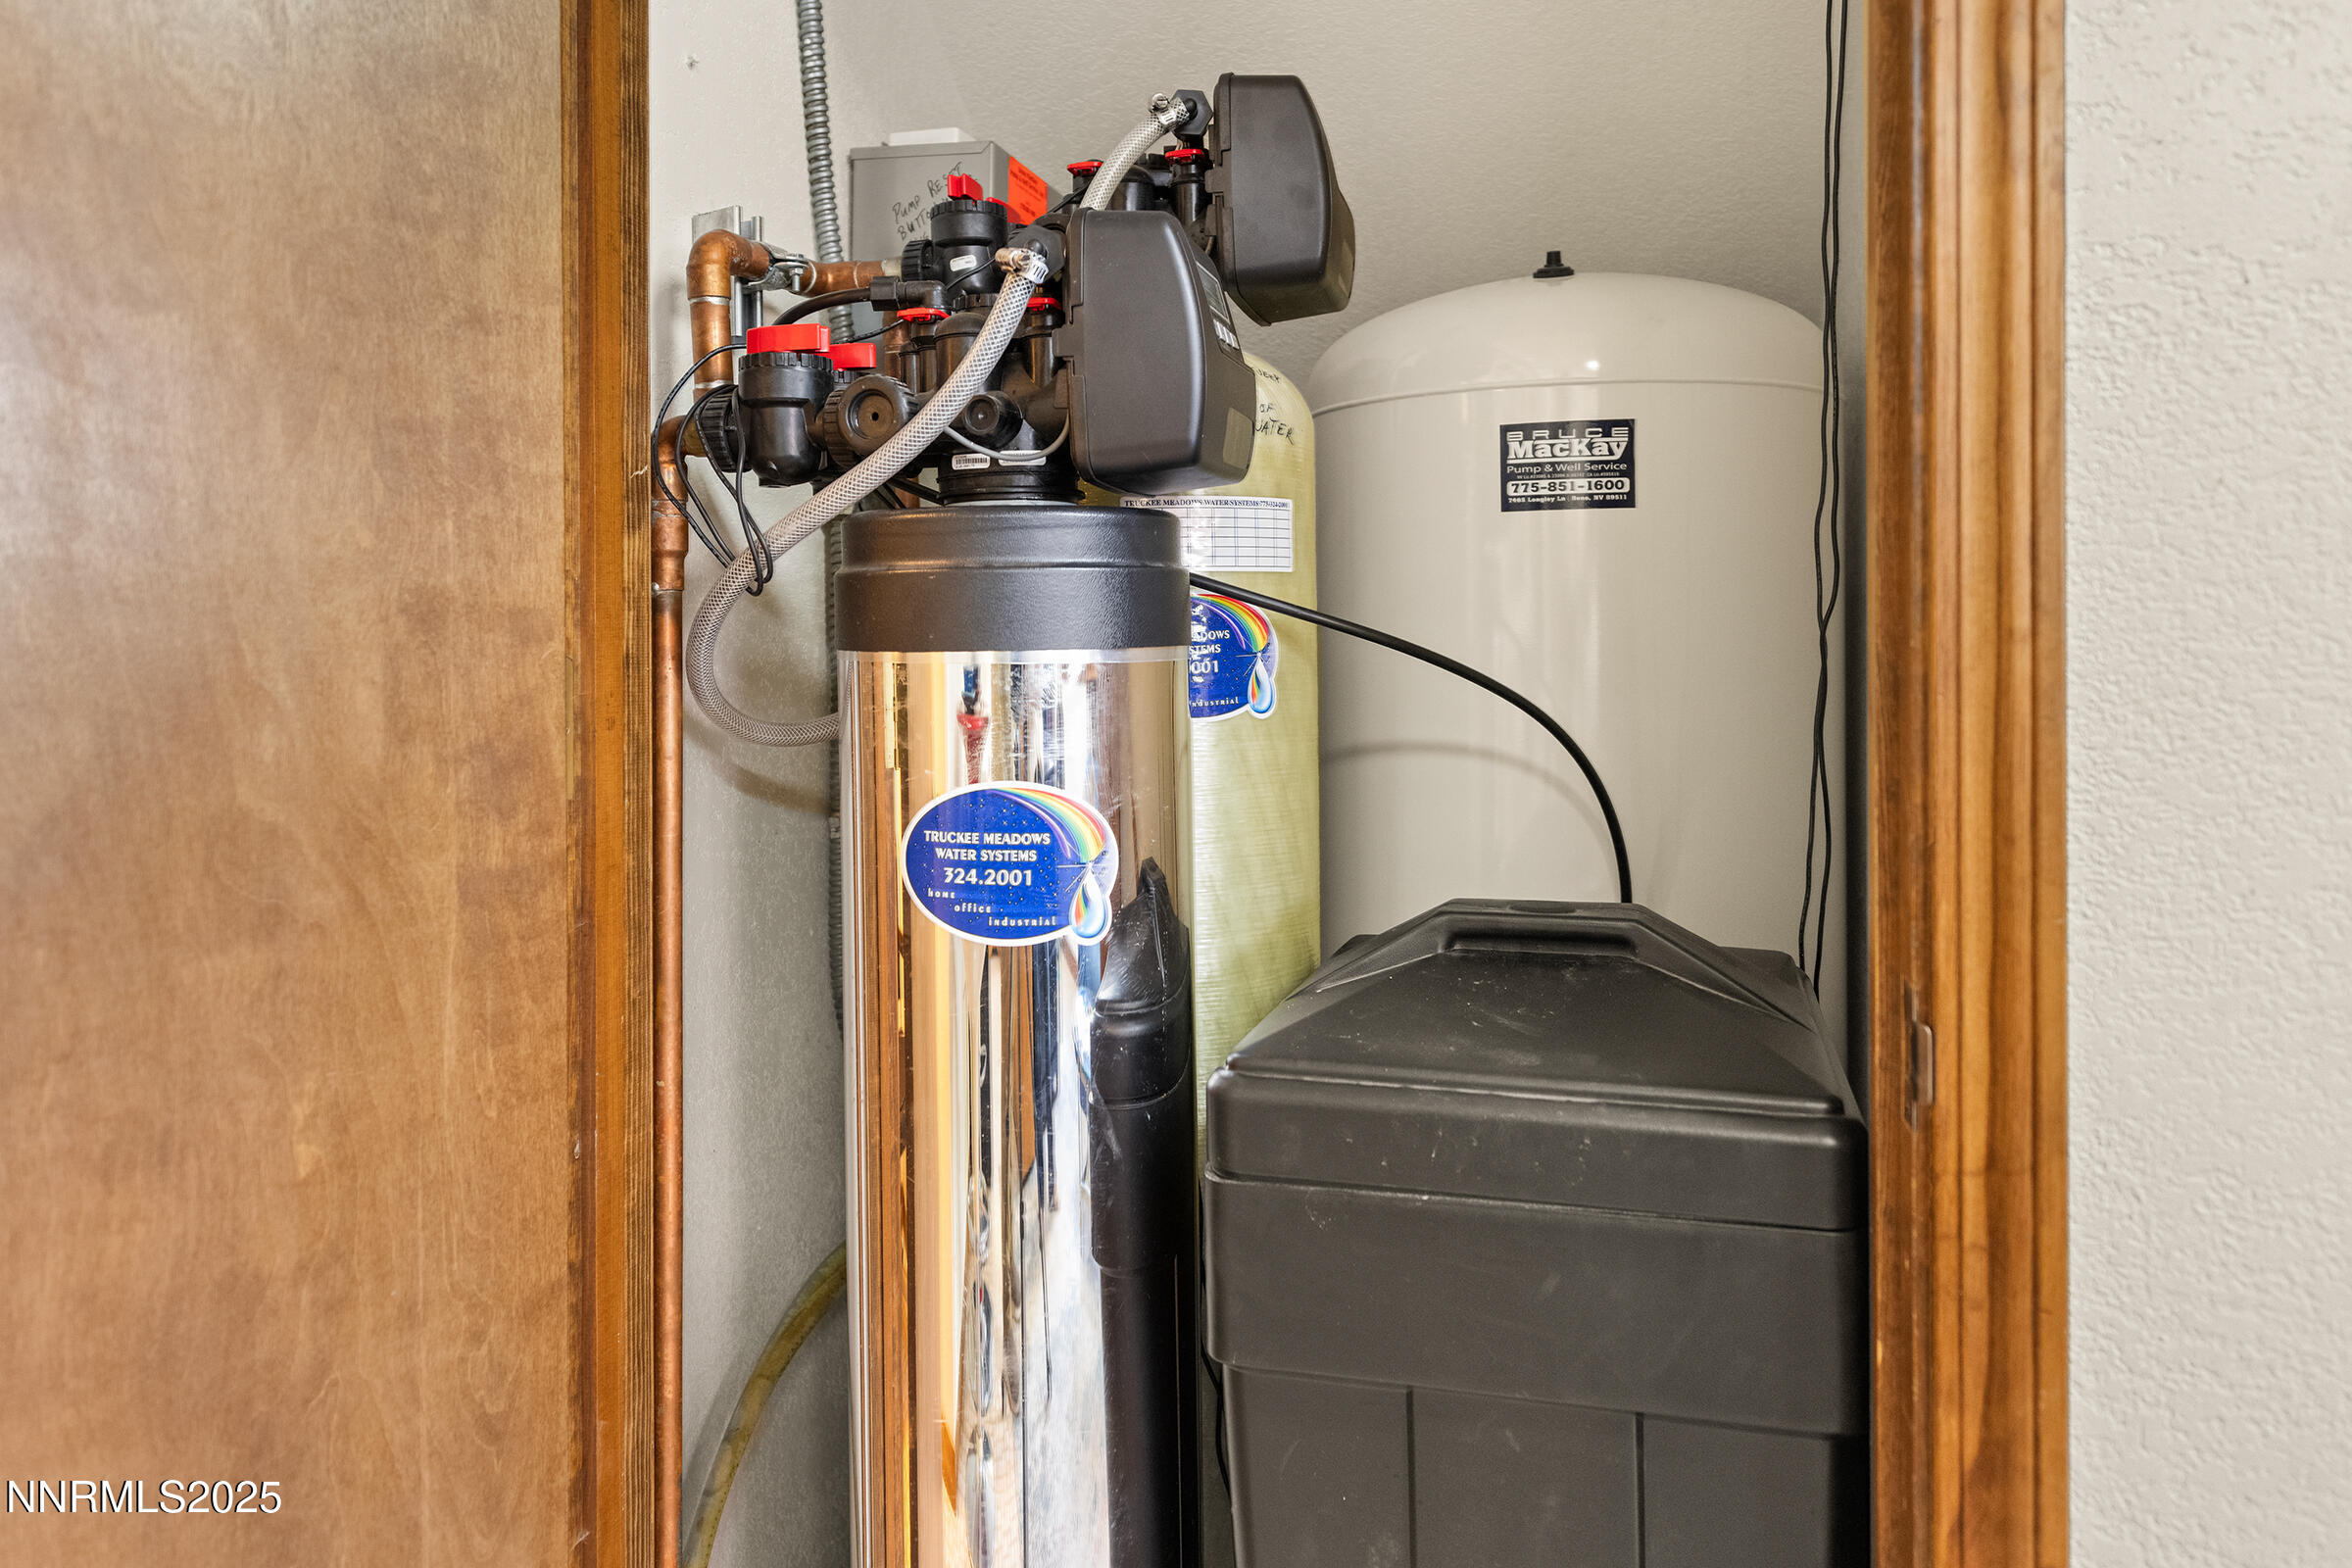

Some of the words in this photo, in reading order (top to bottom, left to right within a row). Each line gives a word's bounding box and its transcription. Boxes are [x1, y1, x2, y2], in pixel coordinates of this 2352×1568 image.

[897, 208, 932, 241] BUTTO
[1506, 426, 1629, 441] BRUCE
[1506, 437, 1628, 460] MacKay
[1506, 465, 1542, 474] Pump
[1555, 463, 1581, 471] Well
[1584, 462, 1628, 470] Service
[1510, 479, 1625, 493] 775-851-1600
[1124, 499, 1161, 508] TRUCKEE
[1192, 629, 1230, 642] ADOWS
[1189, 644, 1221, 655] STEMS
[1189, 660, 1219, 674] 001
[923, 830, 980, 845] TRUCKEE
[983, 832, 1051, 846] MEADOWS
[935, 848, 977, 860] WATER
[980, 849, 1037, 862] SYSTEMS
[944, 866, 1032, 886] 324.2001
[954, 903, 992, 913] office
